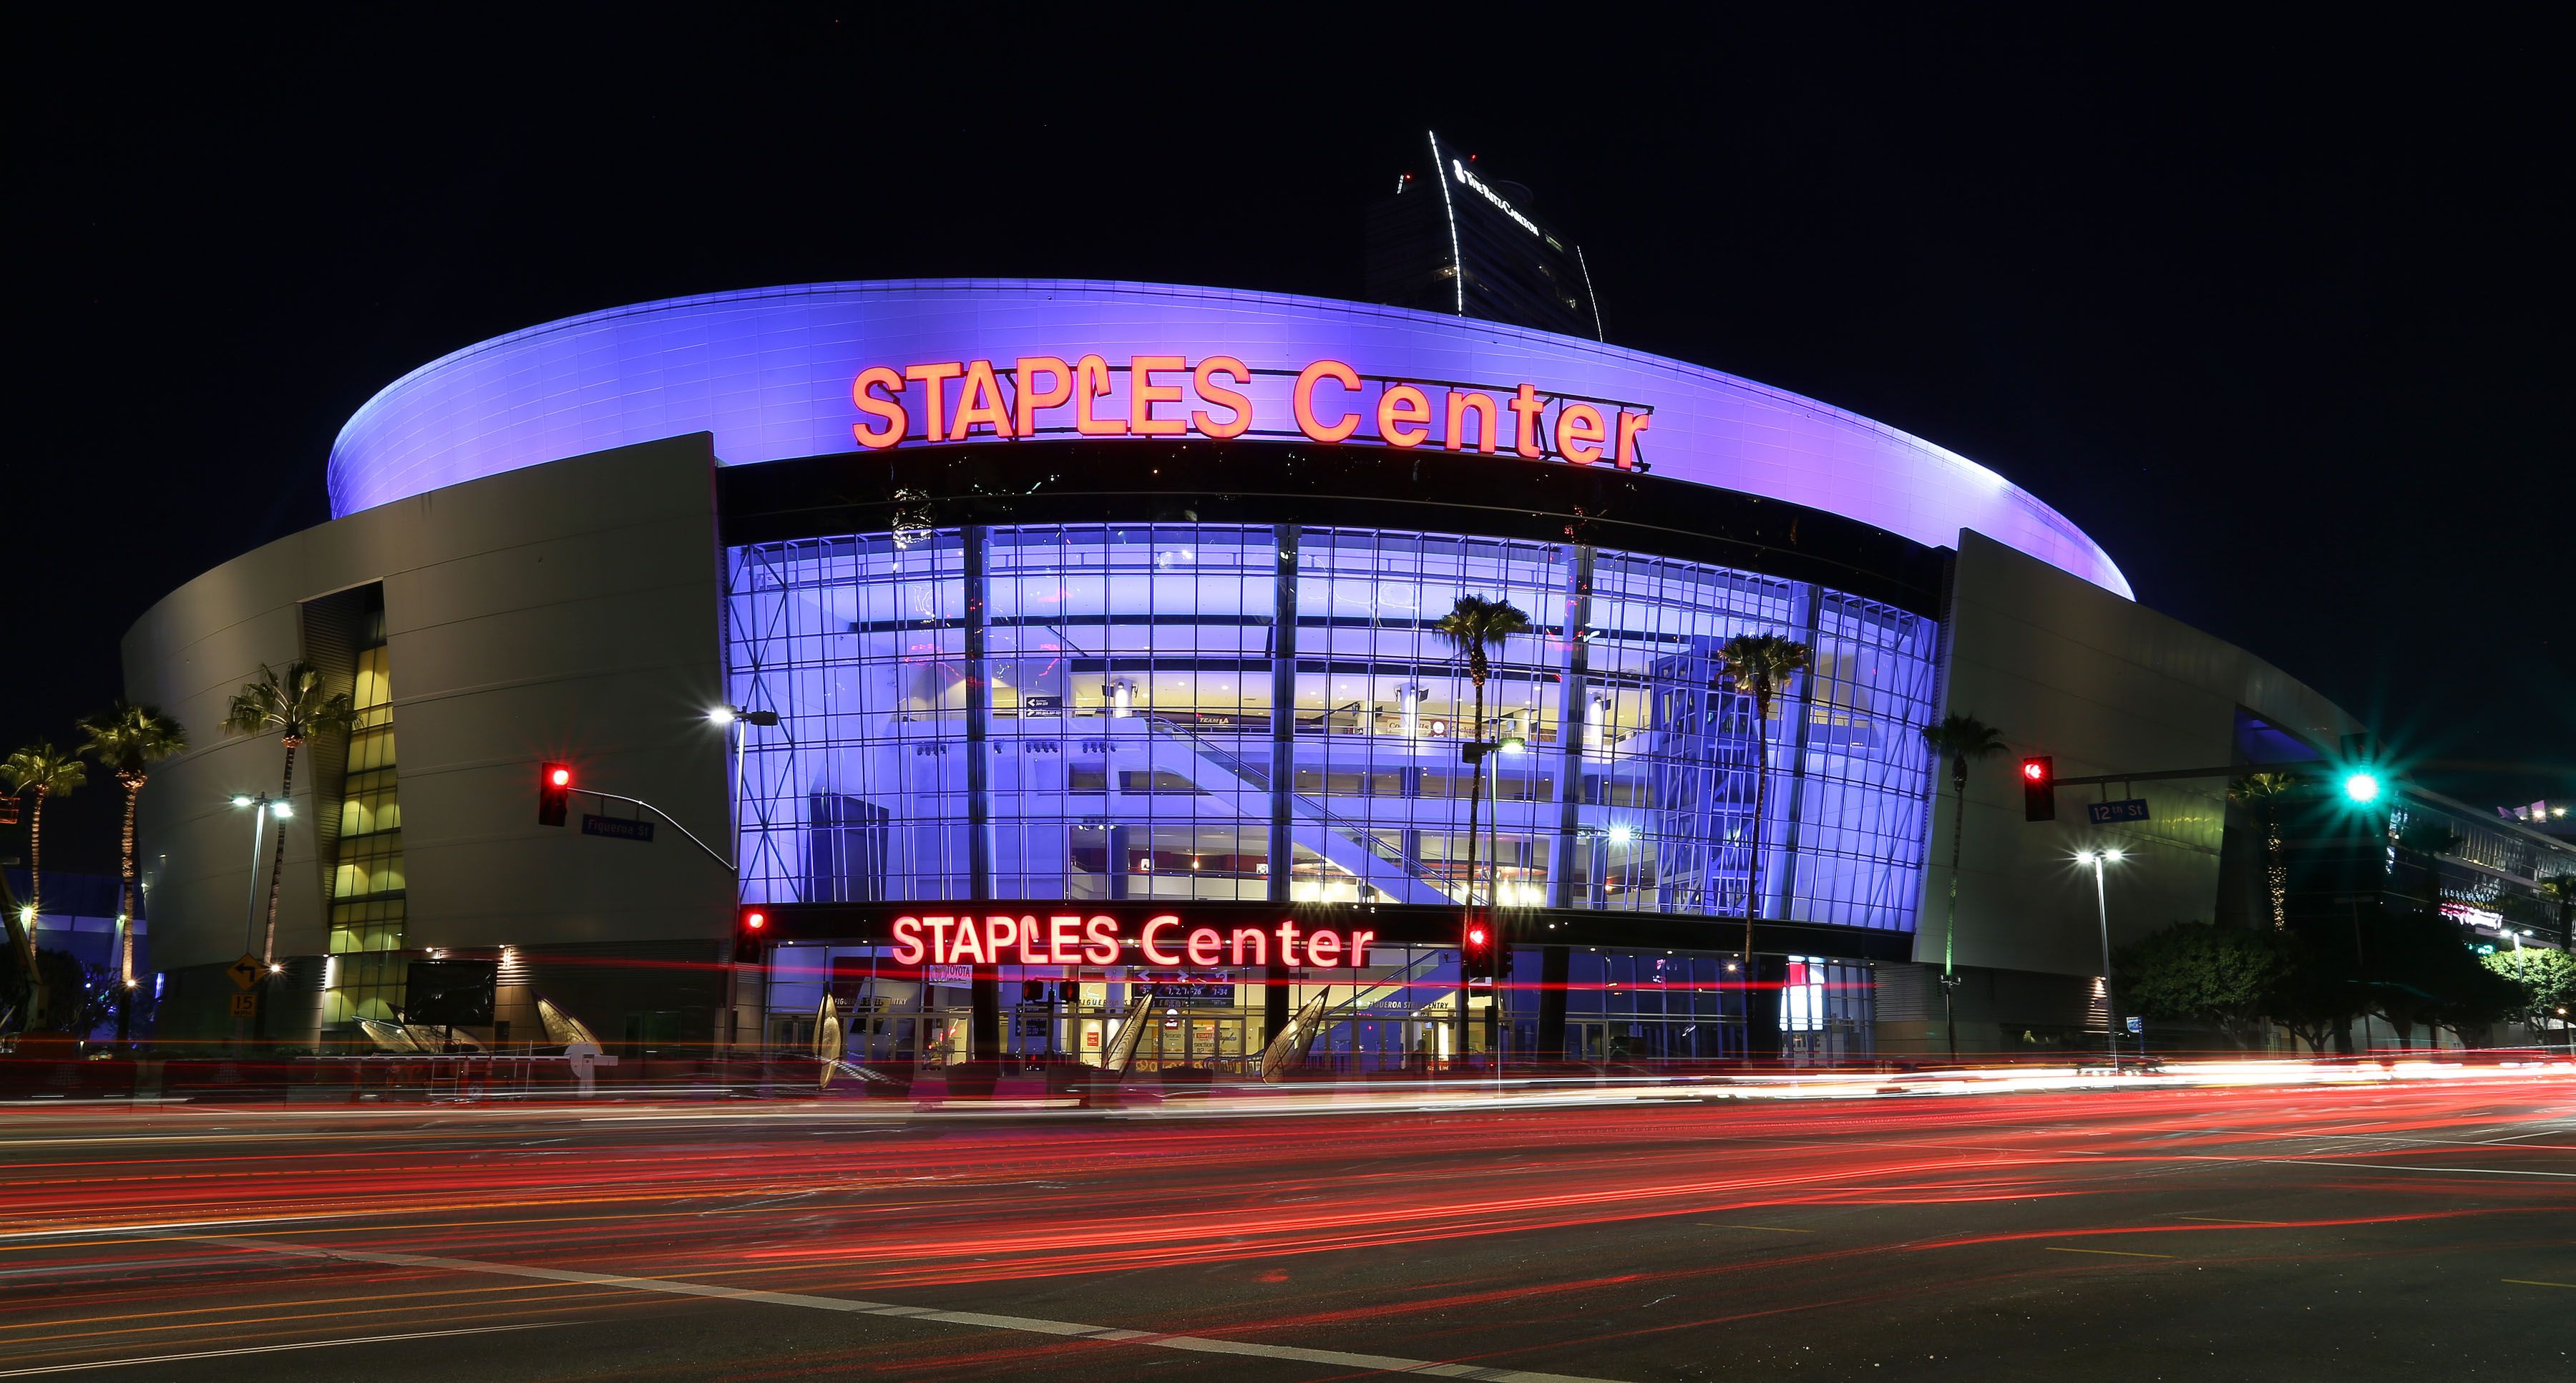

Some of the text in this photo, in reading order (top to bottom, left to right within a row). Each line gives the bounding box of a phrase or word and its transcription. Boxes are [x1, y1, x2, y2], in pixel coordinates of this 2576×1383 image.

[852, 354, 1649, 469] STAPLES Center
[2094, 805, 2142, 821] 12th St
[588, 818, 649, 836] Figueroa St
[892, 915, 1375, 968] STAPLES Center
[947, 965, 970, 977] TOYOTA
[235, 996, 253, 1010] 15
